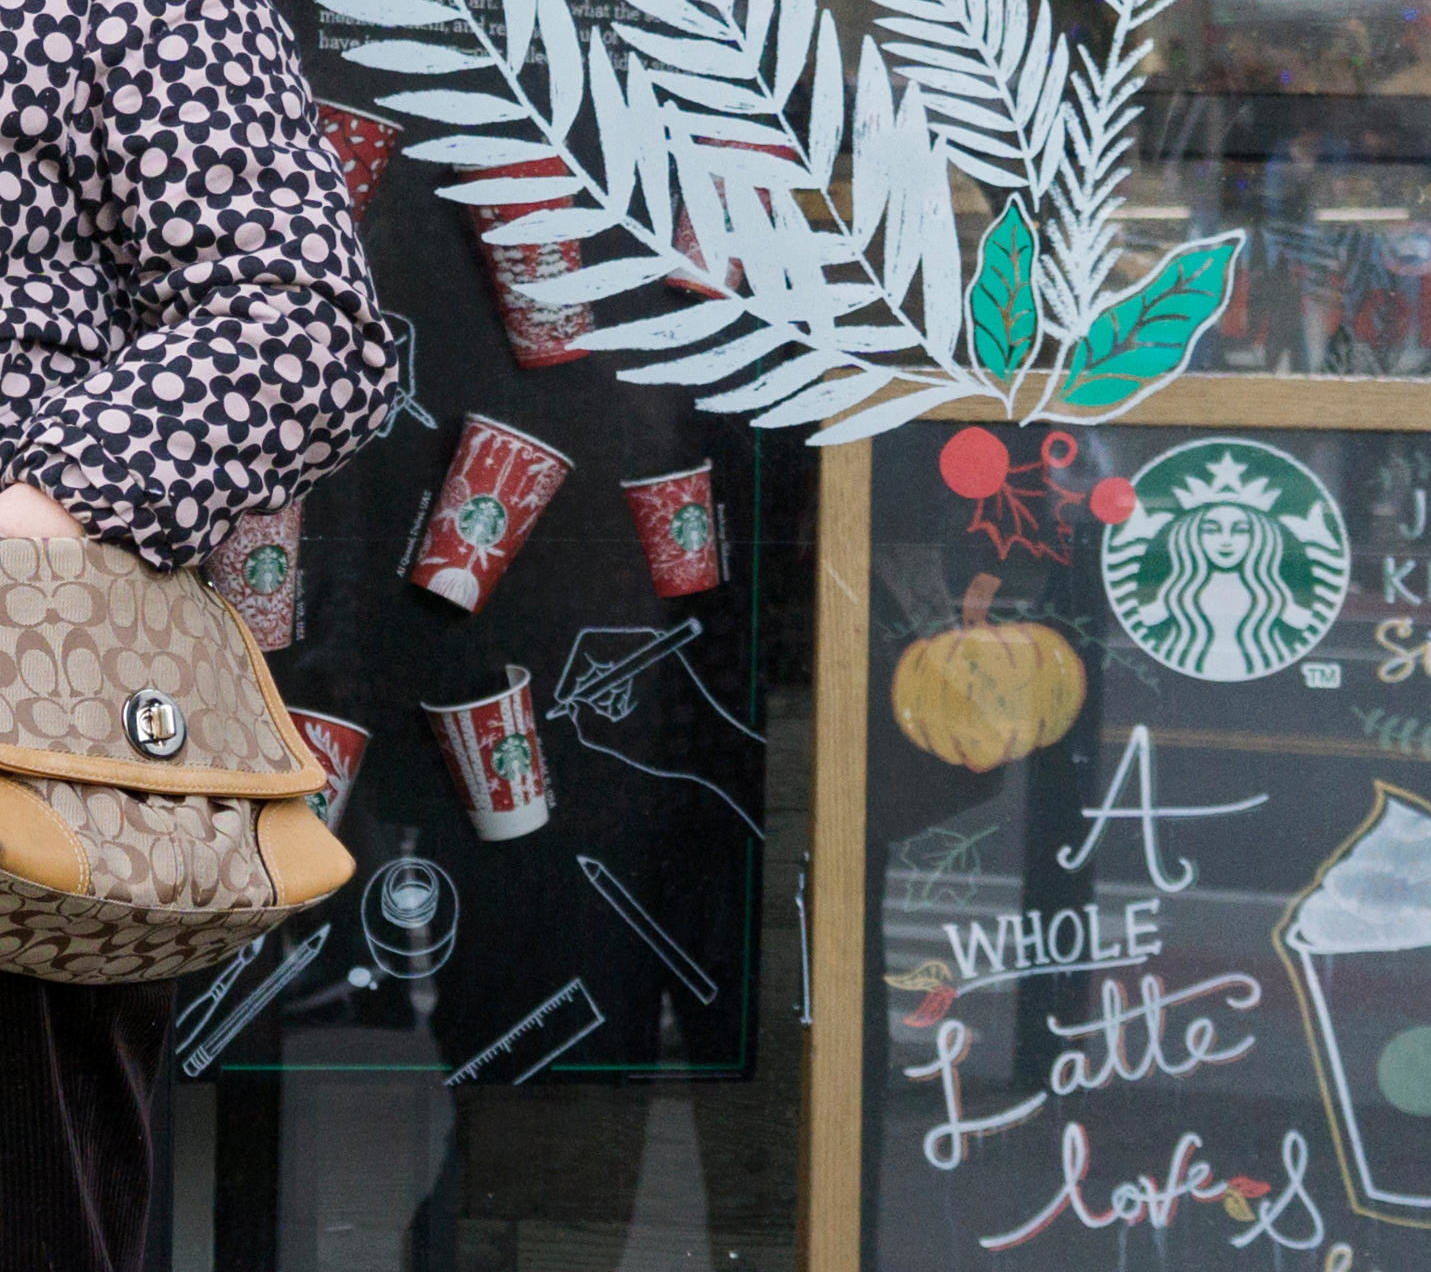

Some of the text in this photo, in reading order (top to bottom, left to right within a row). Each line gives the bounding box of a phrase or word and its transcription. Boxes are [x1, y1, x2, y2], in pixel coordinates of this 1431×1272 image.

[1056, 724, 1269, 892] A
[943, 898, 1163, 978] WHOLE
[903, 974, 1262, 1170] Latte
